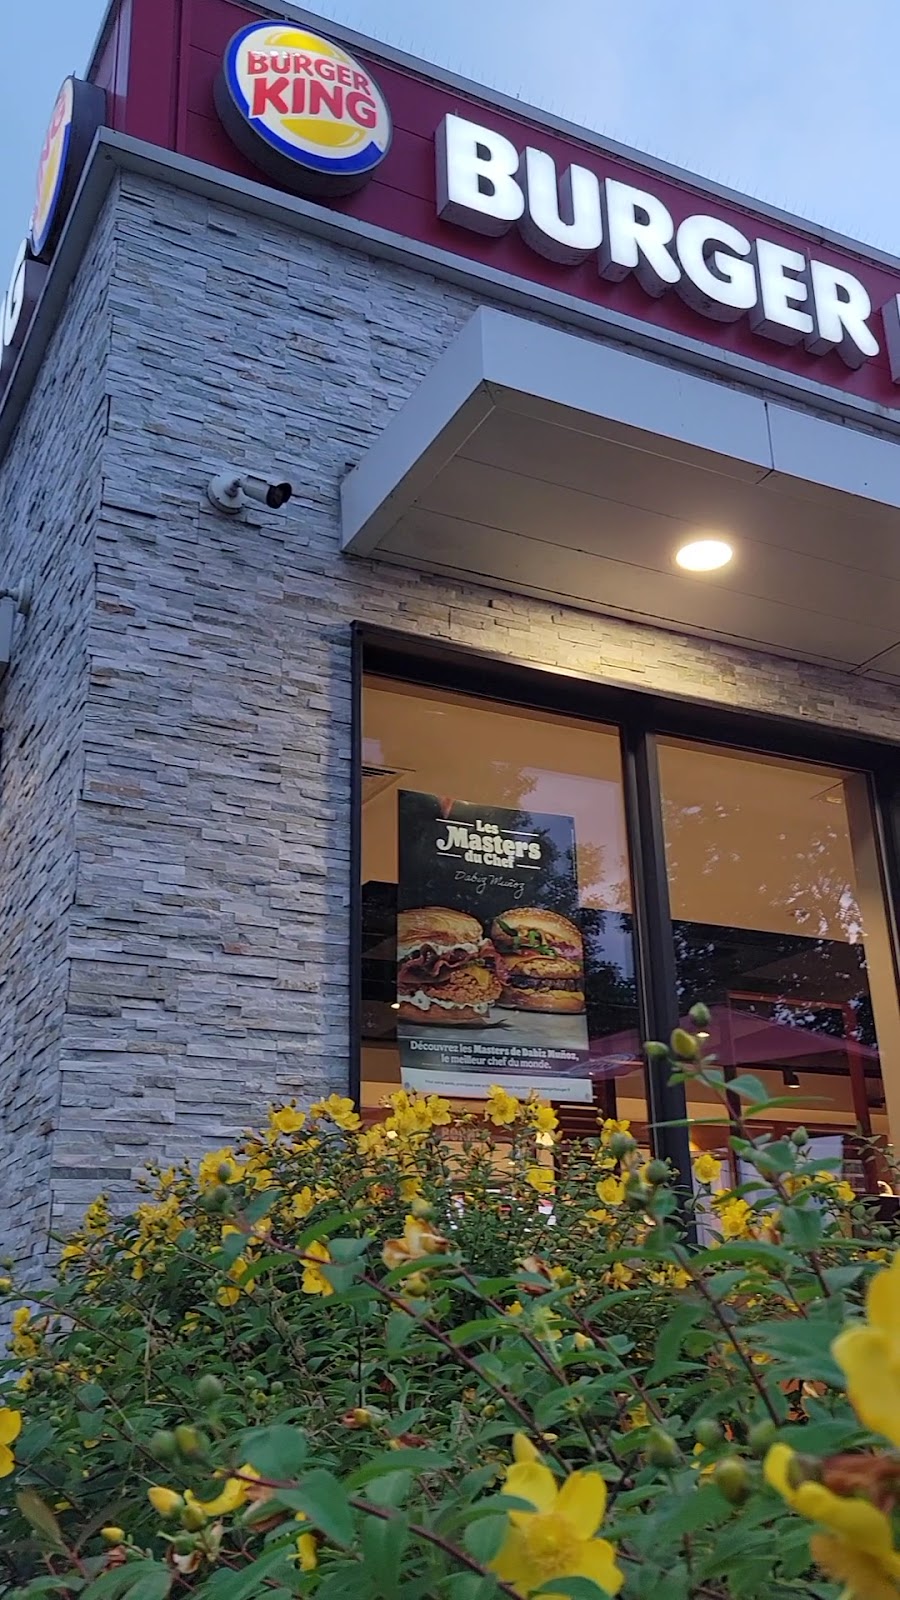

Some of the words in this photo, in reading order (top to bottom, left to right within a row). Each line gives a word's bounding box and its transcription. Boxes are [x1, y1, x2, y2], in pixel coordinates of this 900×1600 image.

[247, 50, 371, 96] BURGER
[252, 77, 377, 129] KING
[444, 112, 880, 358] BURGER
[475, 819, 499, 834] Les
[436, 825, 542, 860] Masters
[464, 850, 483, 864] du
[483, 853, 516, 869] Chef
[454, 870, 488, 894] Dabiz
[489, 874, 526, 900] Muñoz
[410, 1040, 459, 1053] Découvrez
[459, 1043, 473, 1054] les
[473, 1044, 510, 1056] Masters
[510, 1047, 521, 1056] de
[521, 1047, 547, 1058] Dabiz
[441, 1053, 450, 1063] le
[450, 1054, 487, 1065] meilleur
[487, 1056, 508, 1067] chef
[507, 1058, 520, 1067] du
[520, 1060, 552, 1069] monde.
